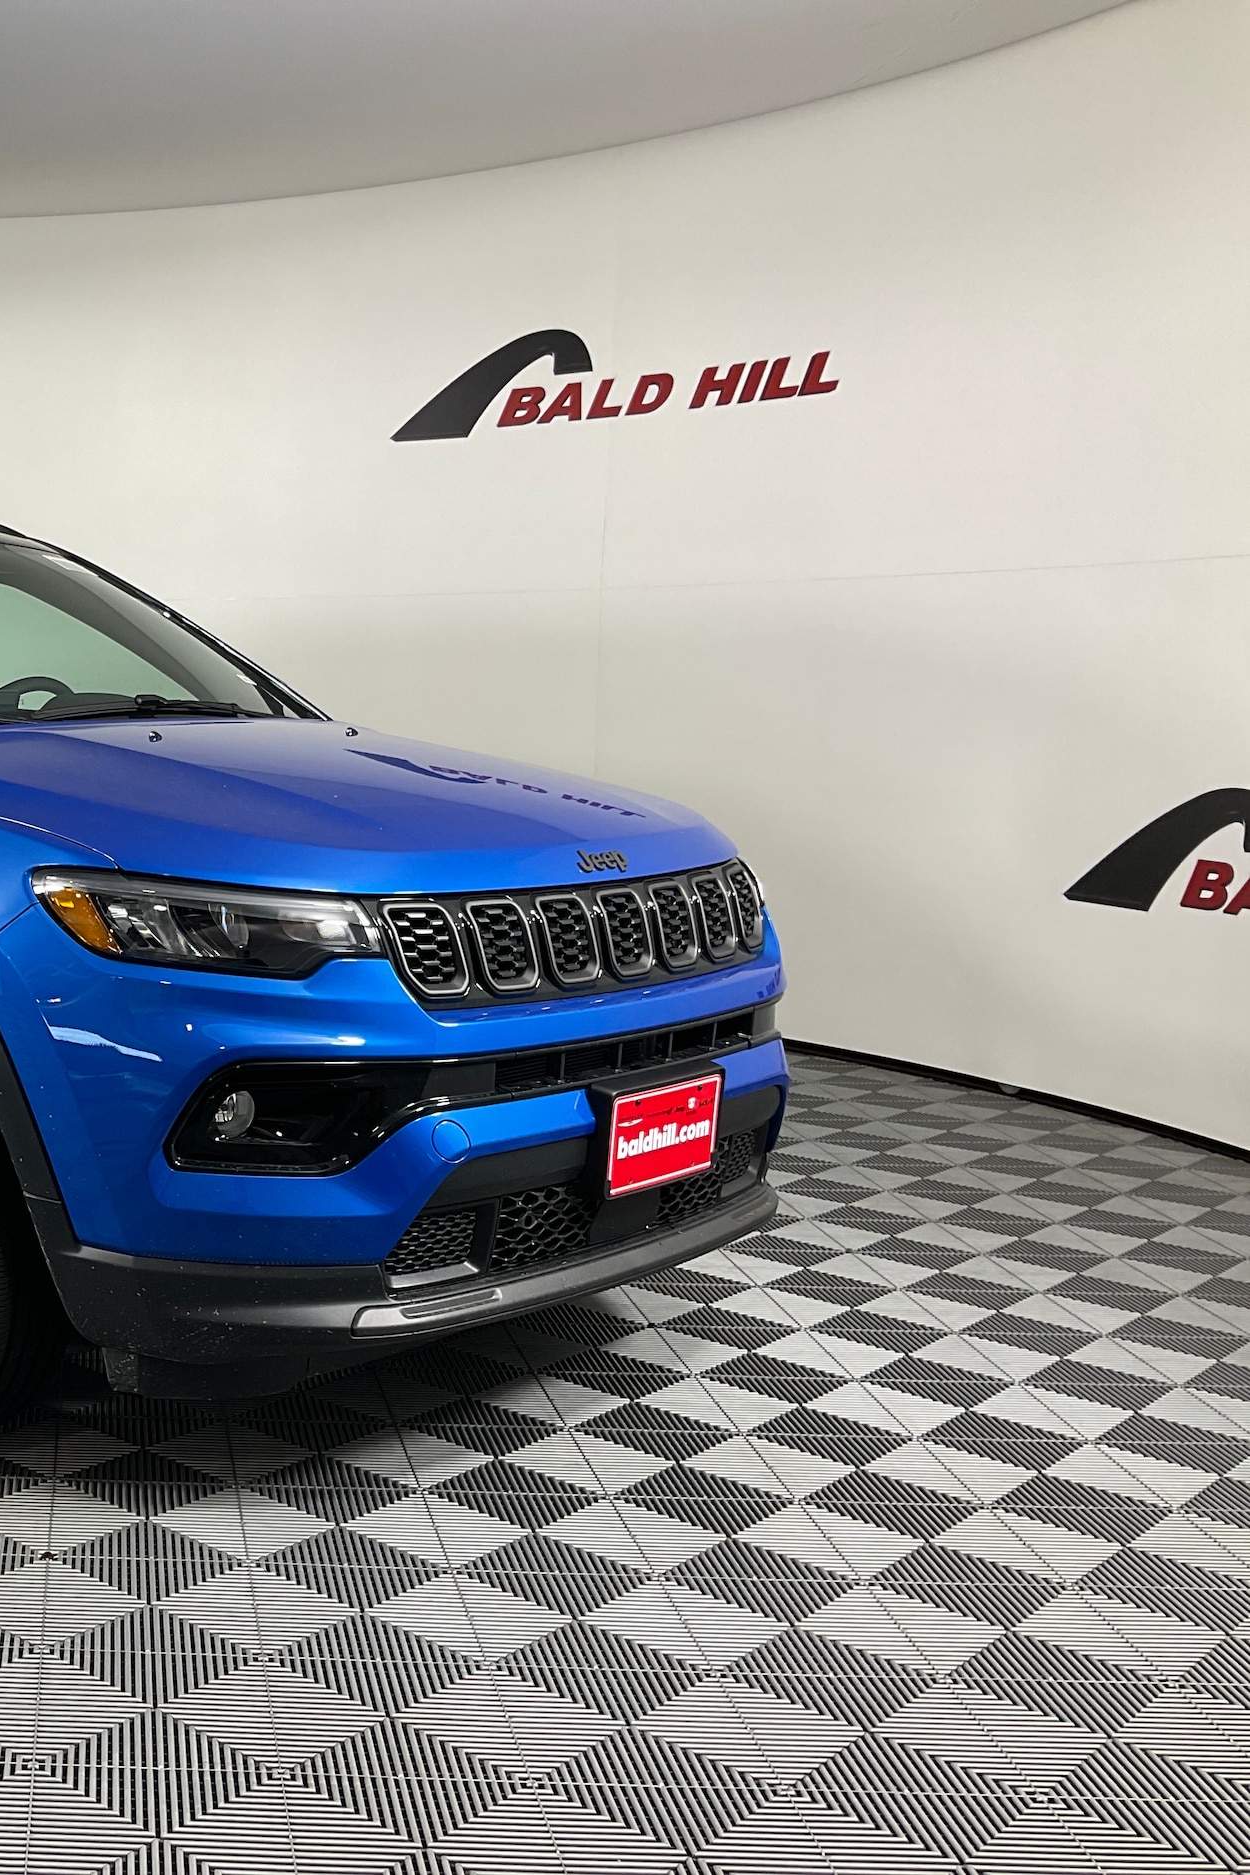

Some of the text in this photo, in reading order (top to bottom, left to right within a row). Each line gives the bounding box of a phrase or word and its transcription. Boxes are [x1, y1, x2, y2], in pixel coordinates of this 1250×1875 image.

[497, 351, 839, 427] BALD HILL
[577, 850, 629, 873] Jeep
[617, 1119, 710, 1160] baldhill.com
